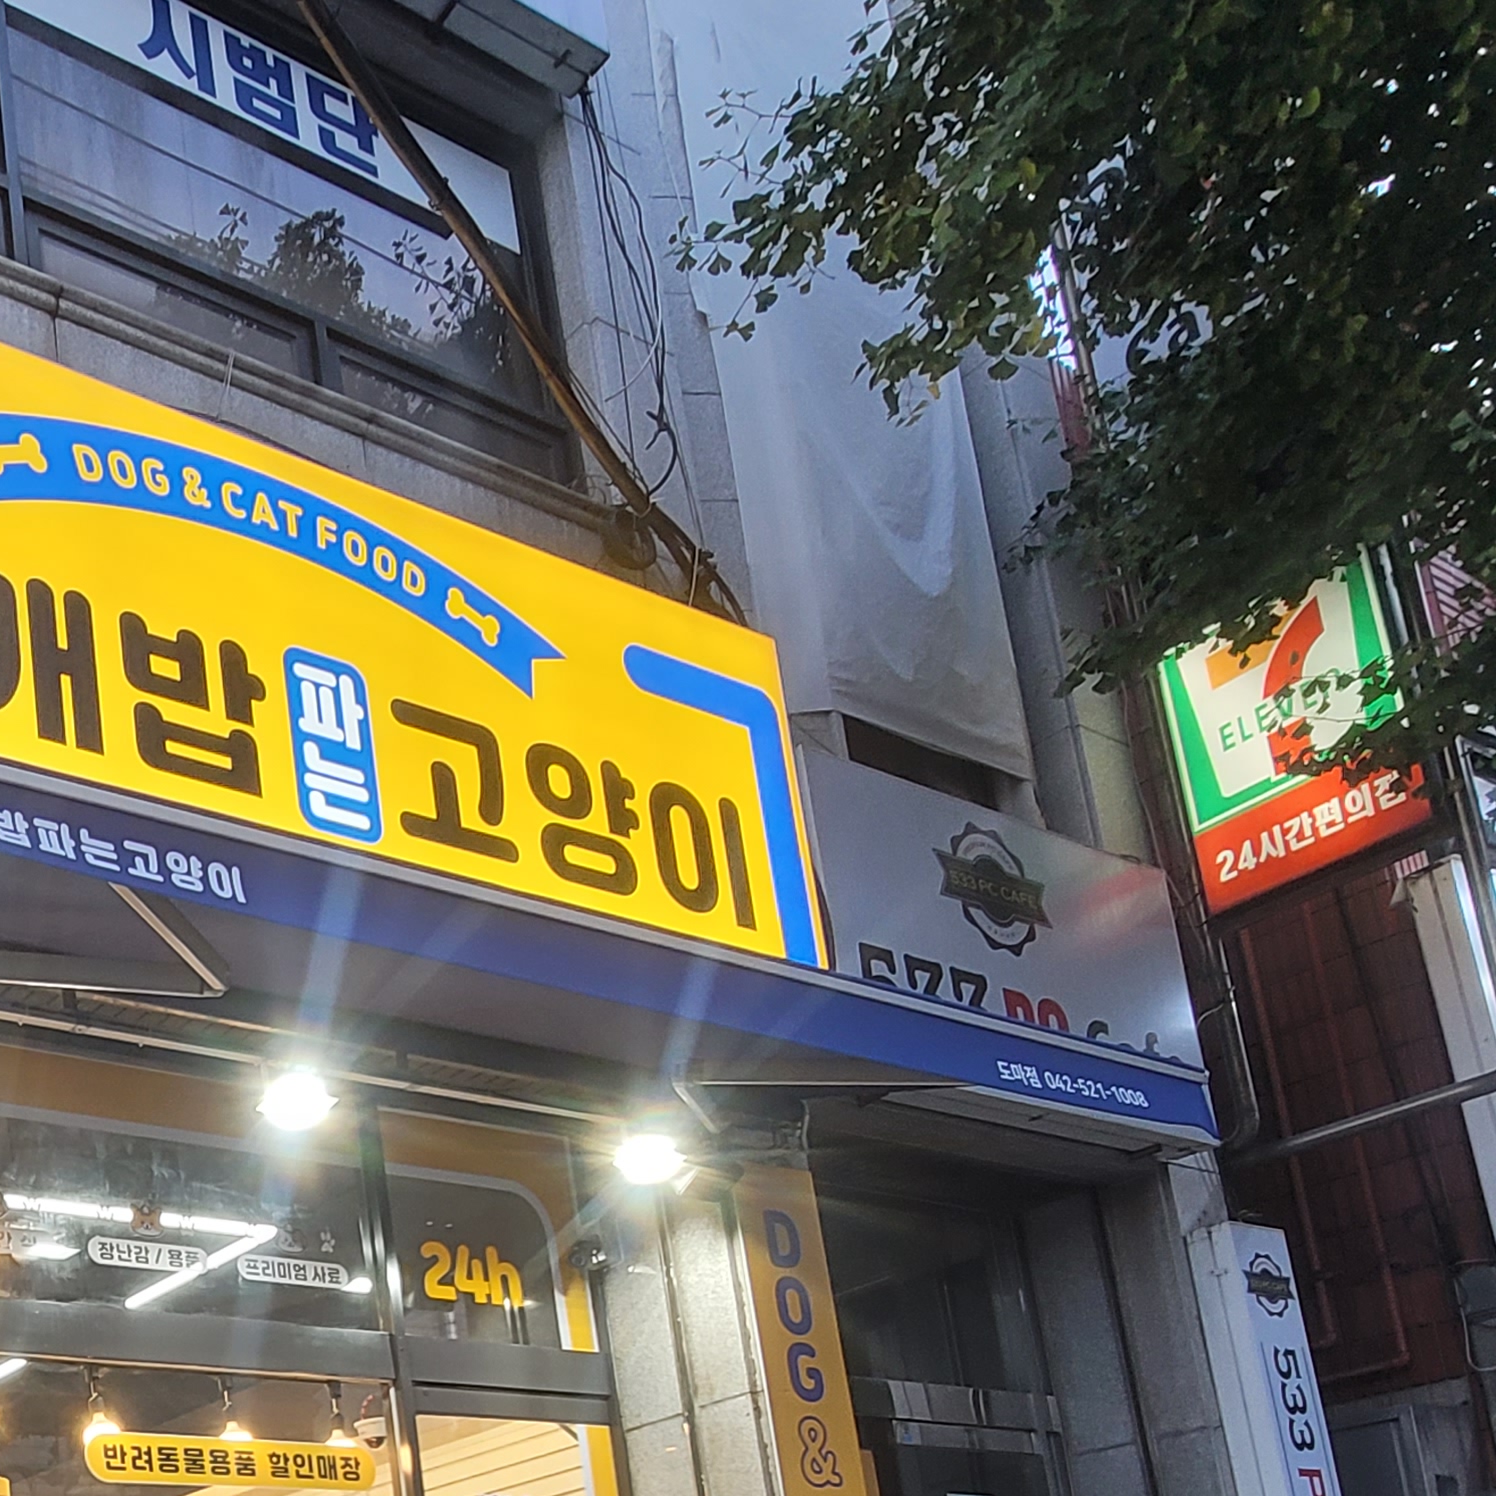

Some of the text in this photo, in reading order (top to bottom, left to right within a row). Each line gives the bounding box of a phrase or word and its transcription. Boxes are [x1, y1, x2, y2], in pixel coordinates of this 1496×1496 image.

[72, 443, 426, 596] DOG & CAT FOOD
[292, 660, 372, 831] 파는
[390, 698, 758, 931] 고양이
[996, 1060, 1150, 1109] 도마점 042-521-1008
[98, 1240, 150, 1263] 장난감
[245, 1258, 342, 1285] 프리미엄 사료
[420, 1241, 524, 1307] 24h
[763, 1209, 824, 1402] DOG
[798, 1415, 843, 1488] &
[1273, 1344, 1316, 1452] 533
[103, 1443, 361, 1482] 반려동물용품 할인매장
